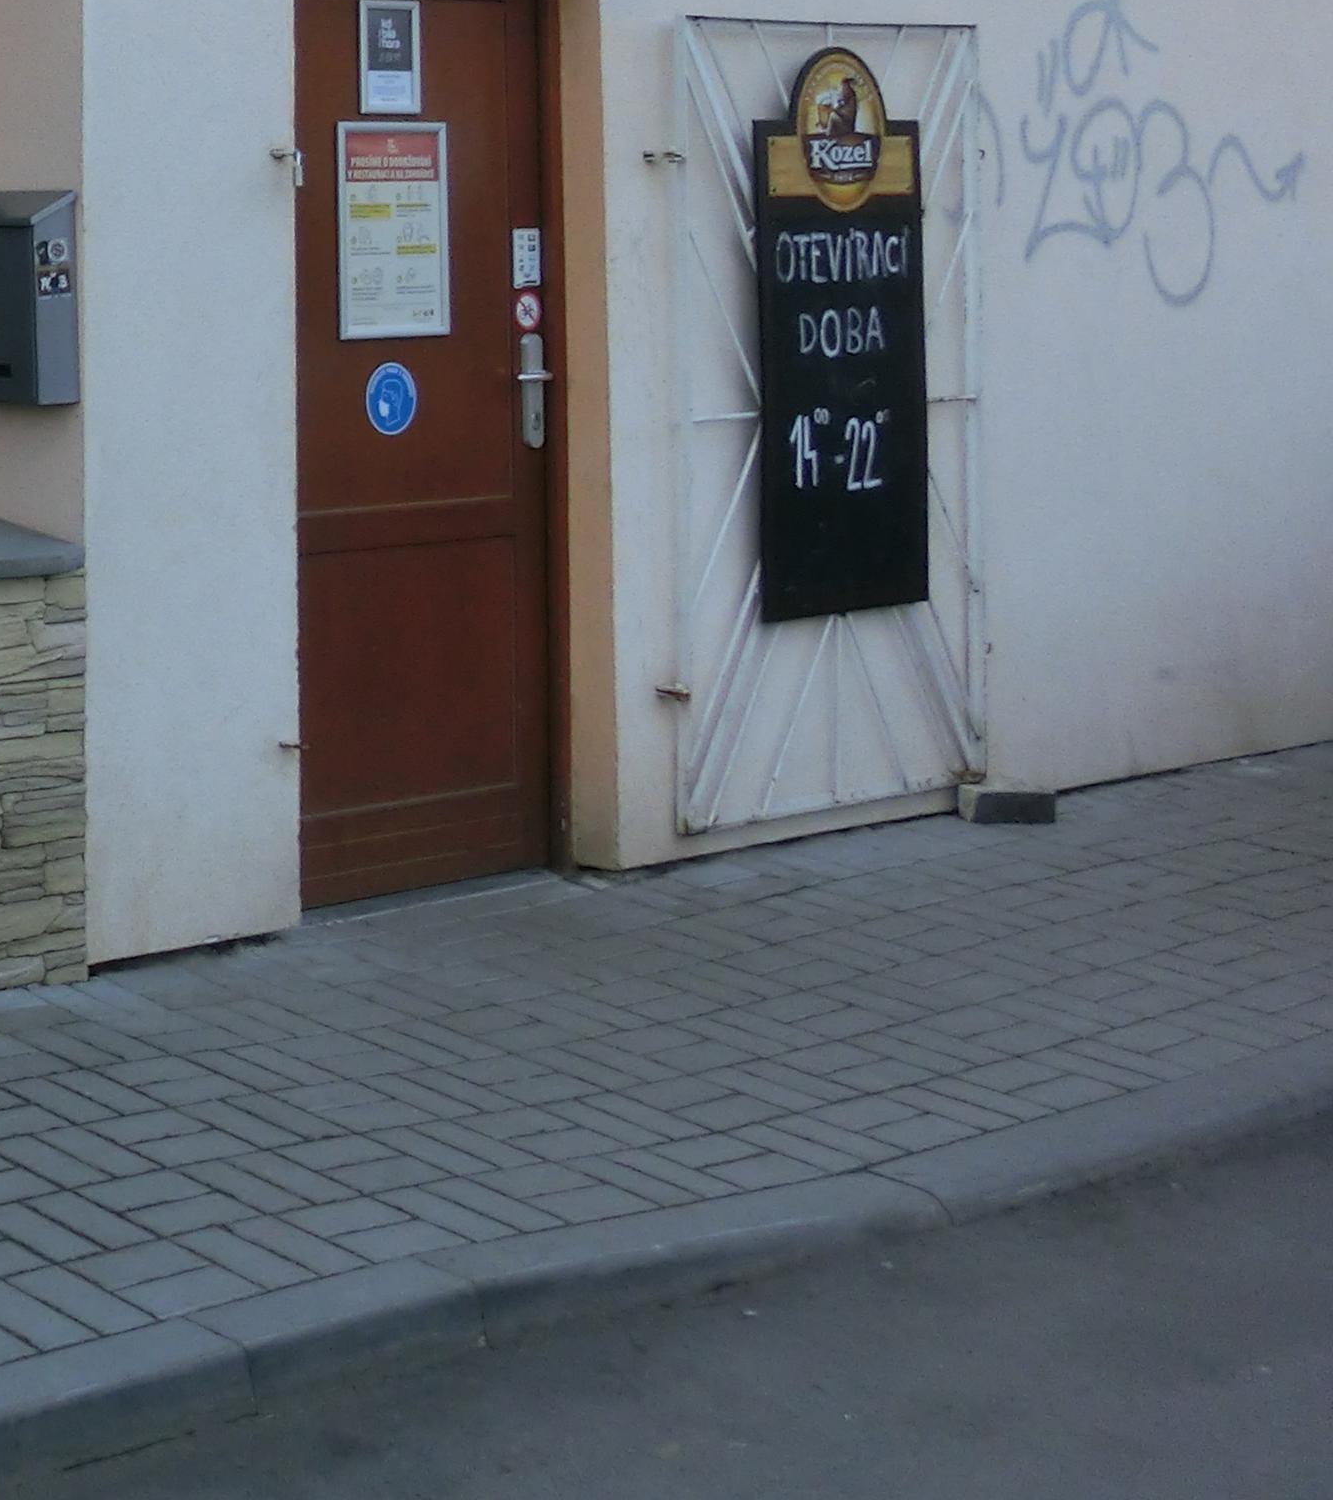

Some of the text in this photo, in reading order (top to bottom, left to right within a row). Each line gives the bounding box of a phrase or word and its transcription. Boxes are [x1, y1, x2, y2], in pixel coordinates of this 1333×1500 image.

[808, 139, 873, 170] Kozel
[776, 226, 909, 285] OTEVÍRACÍ
[800, 306, 885, 358] DOBA
